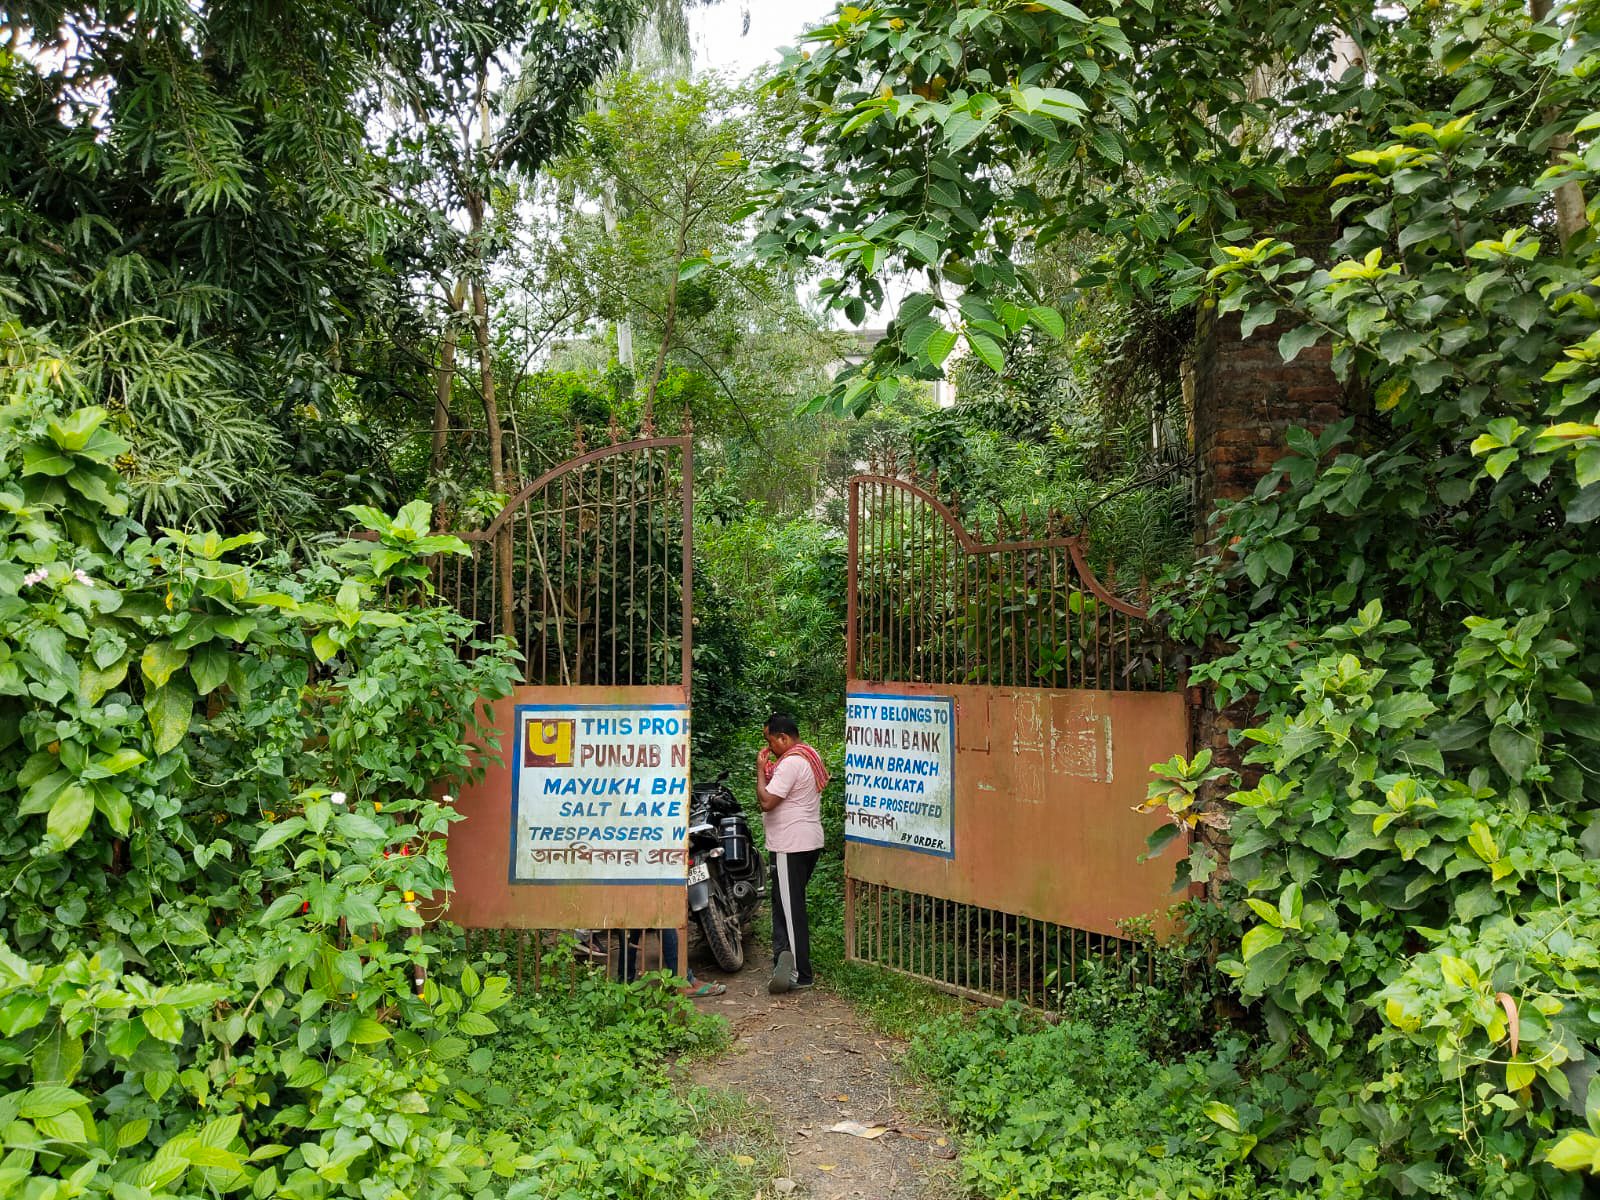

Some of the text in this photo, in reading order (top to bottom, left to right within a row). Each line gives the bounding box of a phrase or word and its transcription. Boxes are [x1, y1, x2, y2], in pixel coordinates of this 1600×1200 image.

[846, 704, 948, 725] ERTY BELONGS TO
[581, 718, 633, 735] THIS
[845, 726, 941, 753] ATIONAL BANK
[580, 744, 687, 768] PUNJAB N
[845, 753, 939, 777] AWAN BRANCH
[543, 777, 687, 796] MAYUKH BH
[559, 801, 682, 817] SALT LAKE
[863, 795, 877, 808] BE
[880, 798, 942, 819] PROSECUTED
[528, 826, 687, 841] TRESPASSERS W
[901, 833, 913, 844] BY
